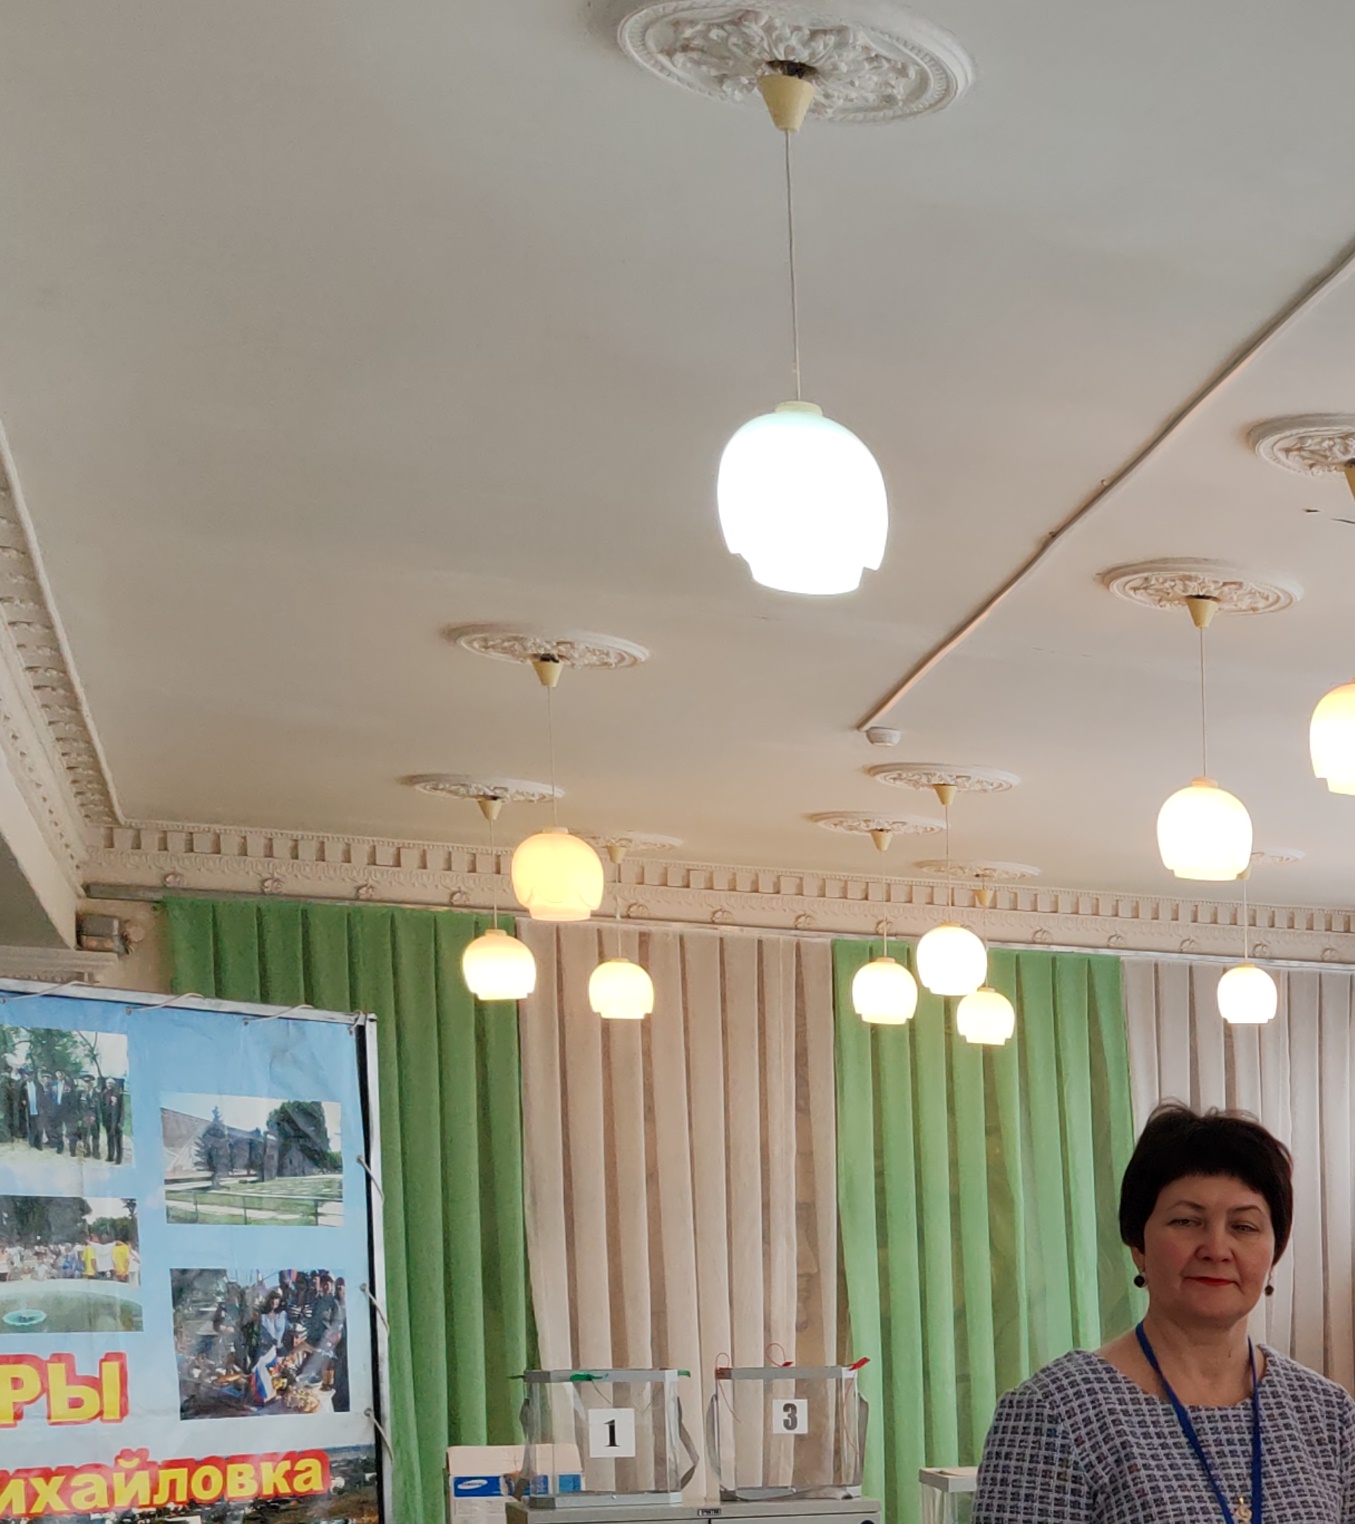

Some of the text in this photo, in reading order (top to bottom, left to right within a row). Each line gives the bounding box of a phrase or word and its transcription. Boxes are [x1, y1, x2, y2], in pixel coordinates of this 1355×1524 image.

[0, 1356, 125, 1426] РЫ
[782, 1402, 799, 1432] 3
[603, 1418, 621, 1448] 1
